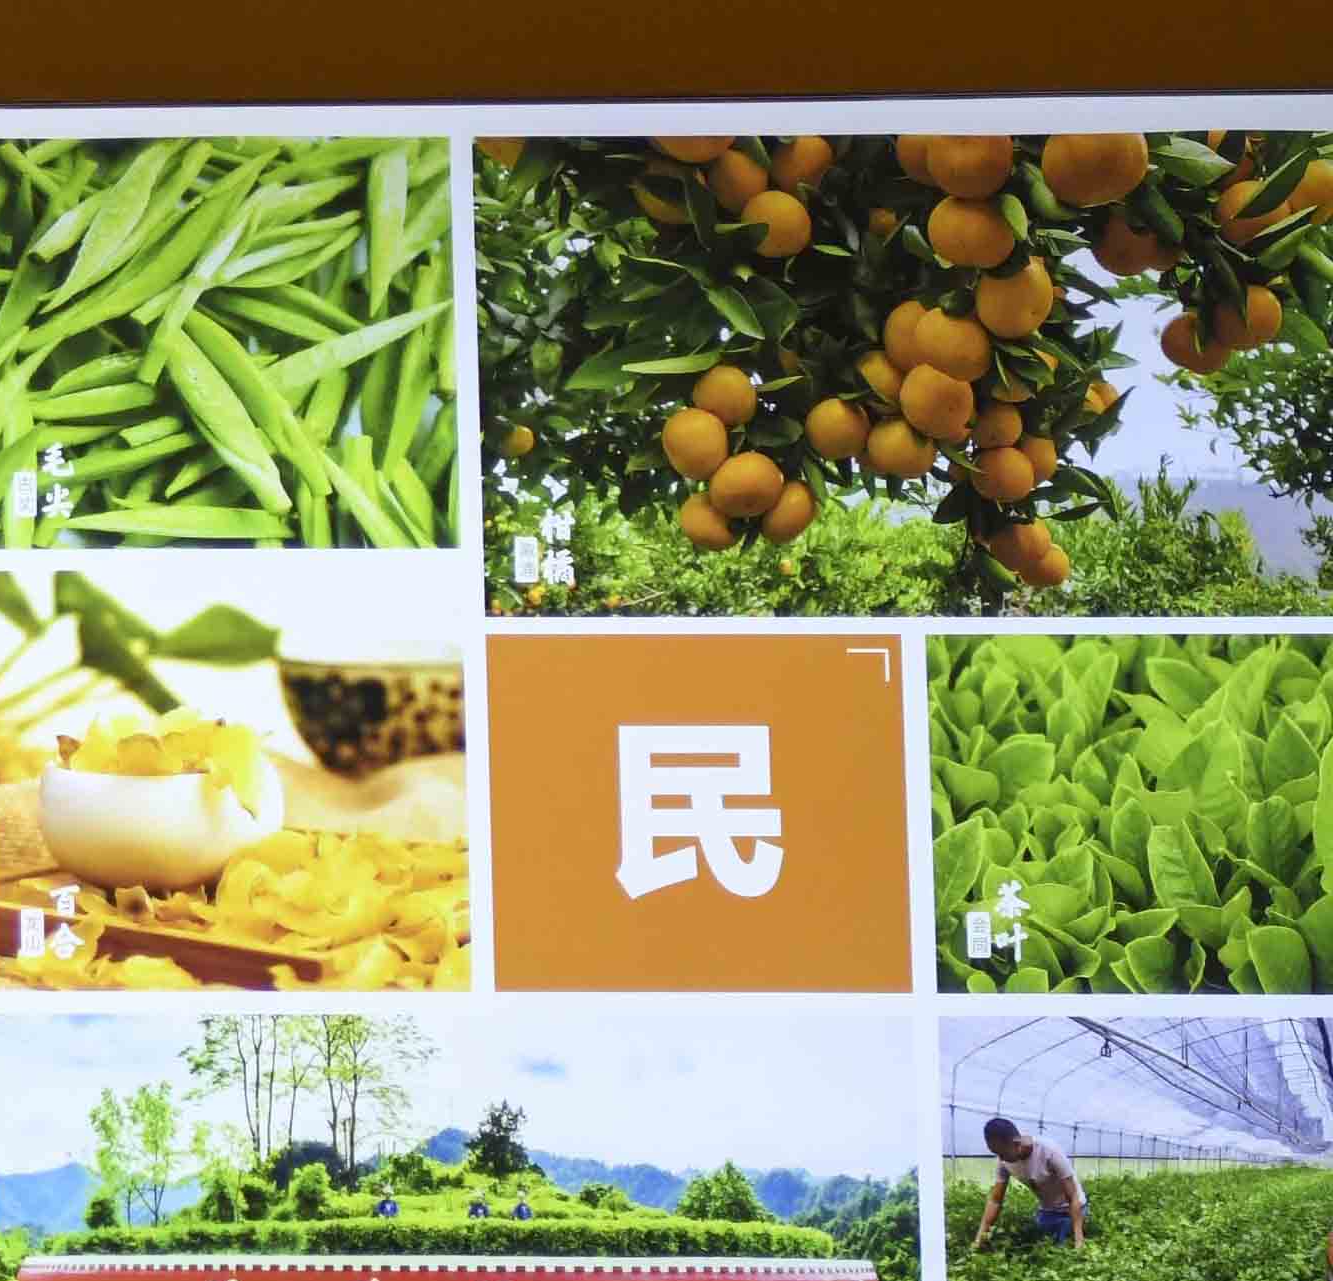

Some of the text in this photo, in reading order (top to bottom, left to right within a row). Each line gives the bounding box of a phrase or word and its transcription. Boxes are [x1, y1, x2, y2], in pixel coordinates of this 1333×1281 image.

[614, 724, 785, 900] 民
[48, 884, 85, 961] 百合
[994, 879, 1030, 963] 茶叶
